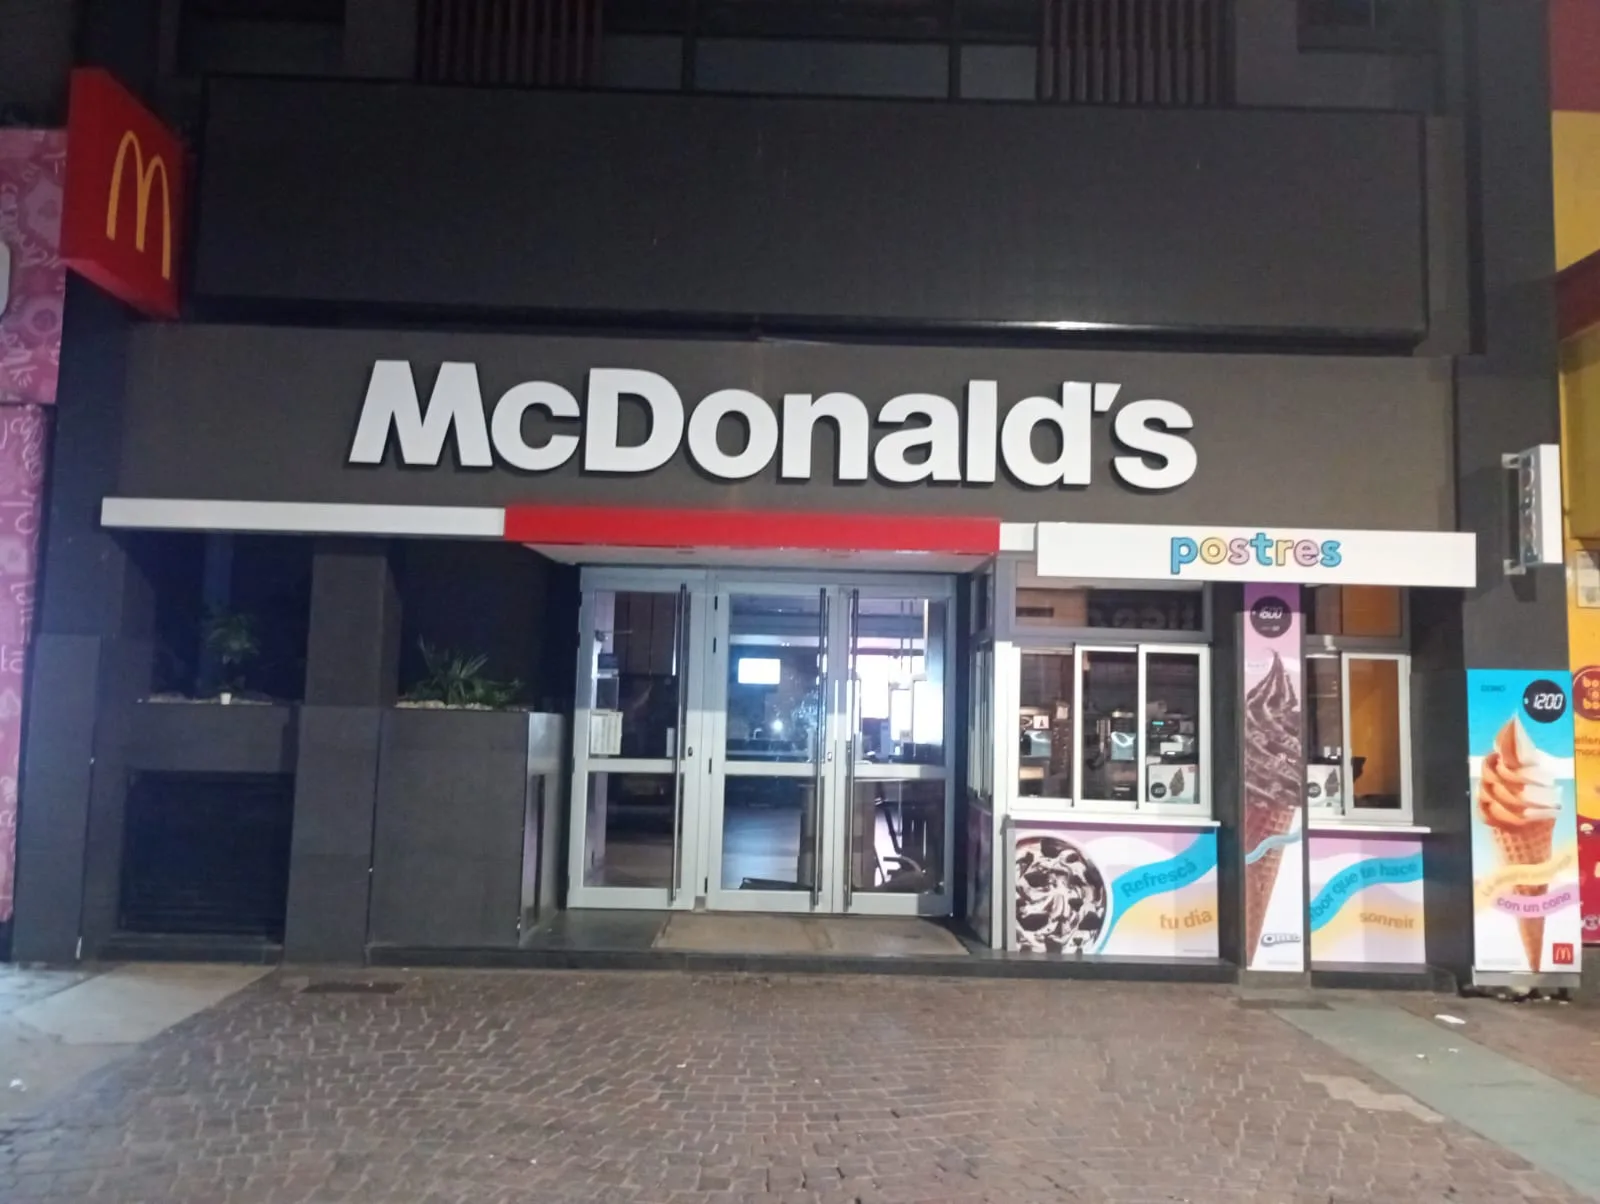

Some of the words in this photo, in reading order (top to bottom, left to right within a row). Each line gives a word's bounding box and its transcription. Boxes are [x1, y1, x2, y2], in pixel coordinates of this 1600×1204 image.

[348, 359, 1198, 491] McDonald's
[1170, 532, 1342, 575] postres
[1583, 676, 1600, 688] bo
[1533, 693, 1563, 710] 1200
[1583, 698, 1600, 710] bo
[1496, 897, 1520, 911] con
[1523, 904, 1539, 912] un
[1542, 892, 1571, 910] cono
[1160, 913, 1179, 929] tu
